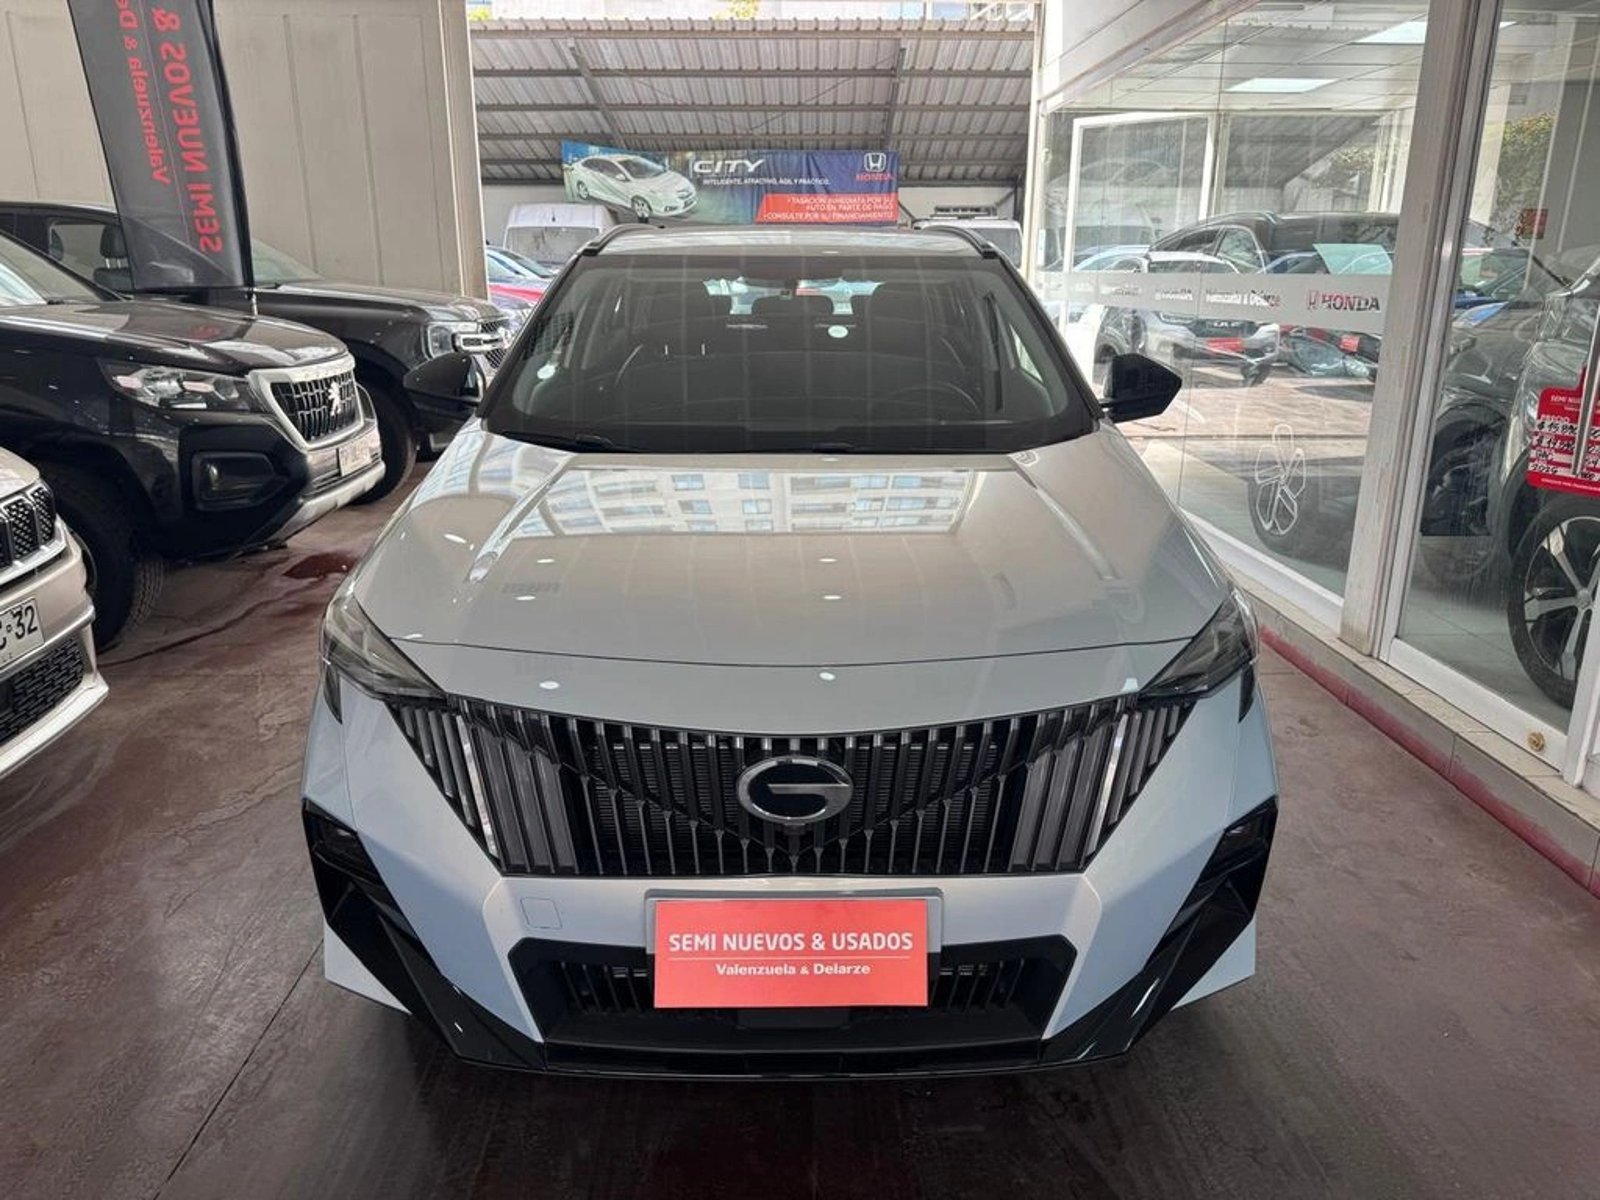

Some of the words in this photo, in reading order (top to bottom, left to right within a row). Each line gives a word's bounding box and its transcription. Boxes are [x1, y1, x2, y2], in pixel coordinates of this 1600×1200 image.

[693, 158, 765, 174] CITY
[856, 172, 894, 182] HONDA
[1321, 292, 1381, 311] HONDA
[669, 933, 716, 951] SEMI
[723, 932, 805, 951] NUEVOS
[811, 932, 825, 950] &
[832, 931, 913, 950] USADOS
[715, 963, 796, 976] Valenzuela
[800, 966, 808, 975] &
[813, 963, 871, 975] Delarze
